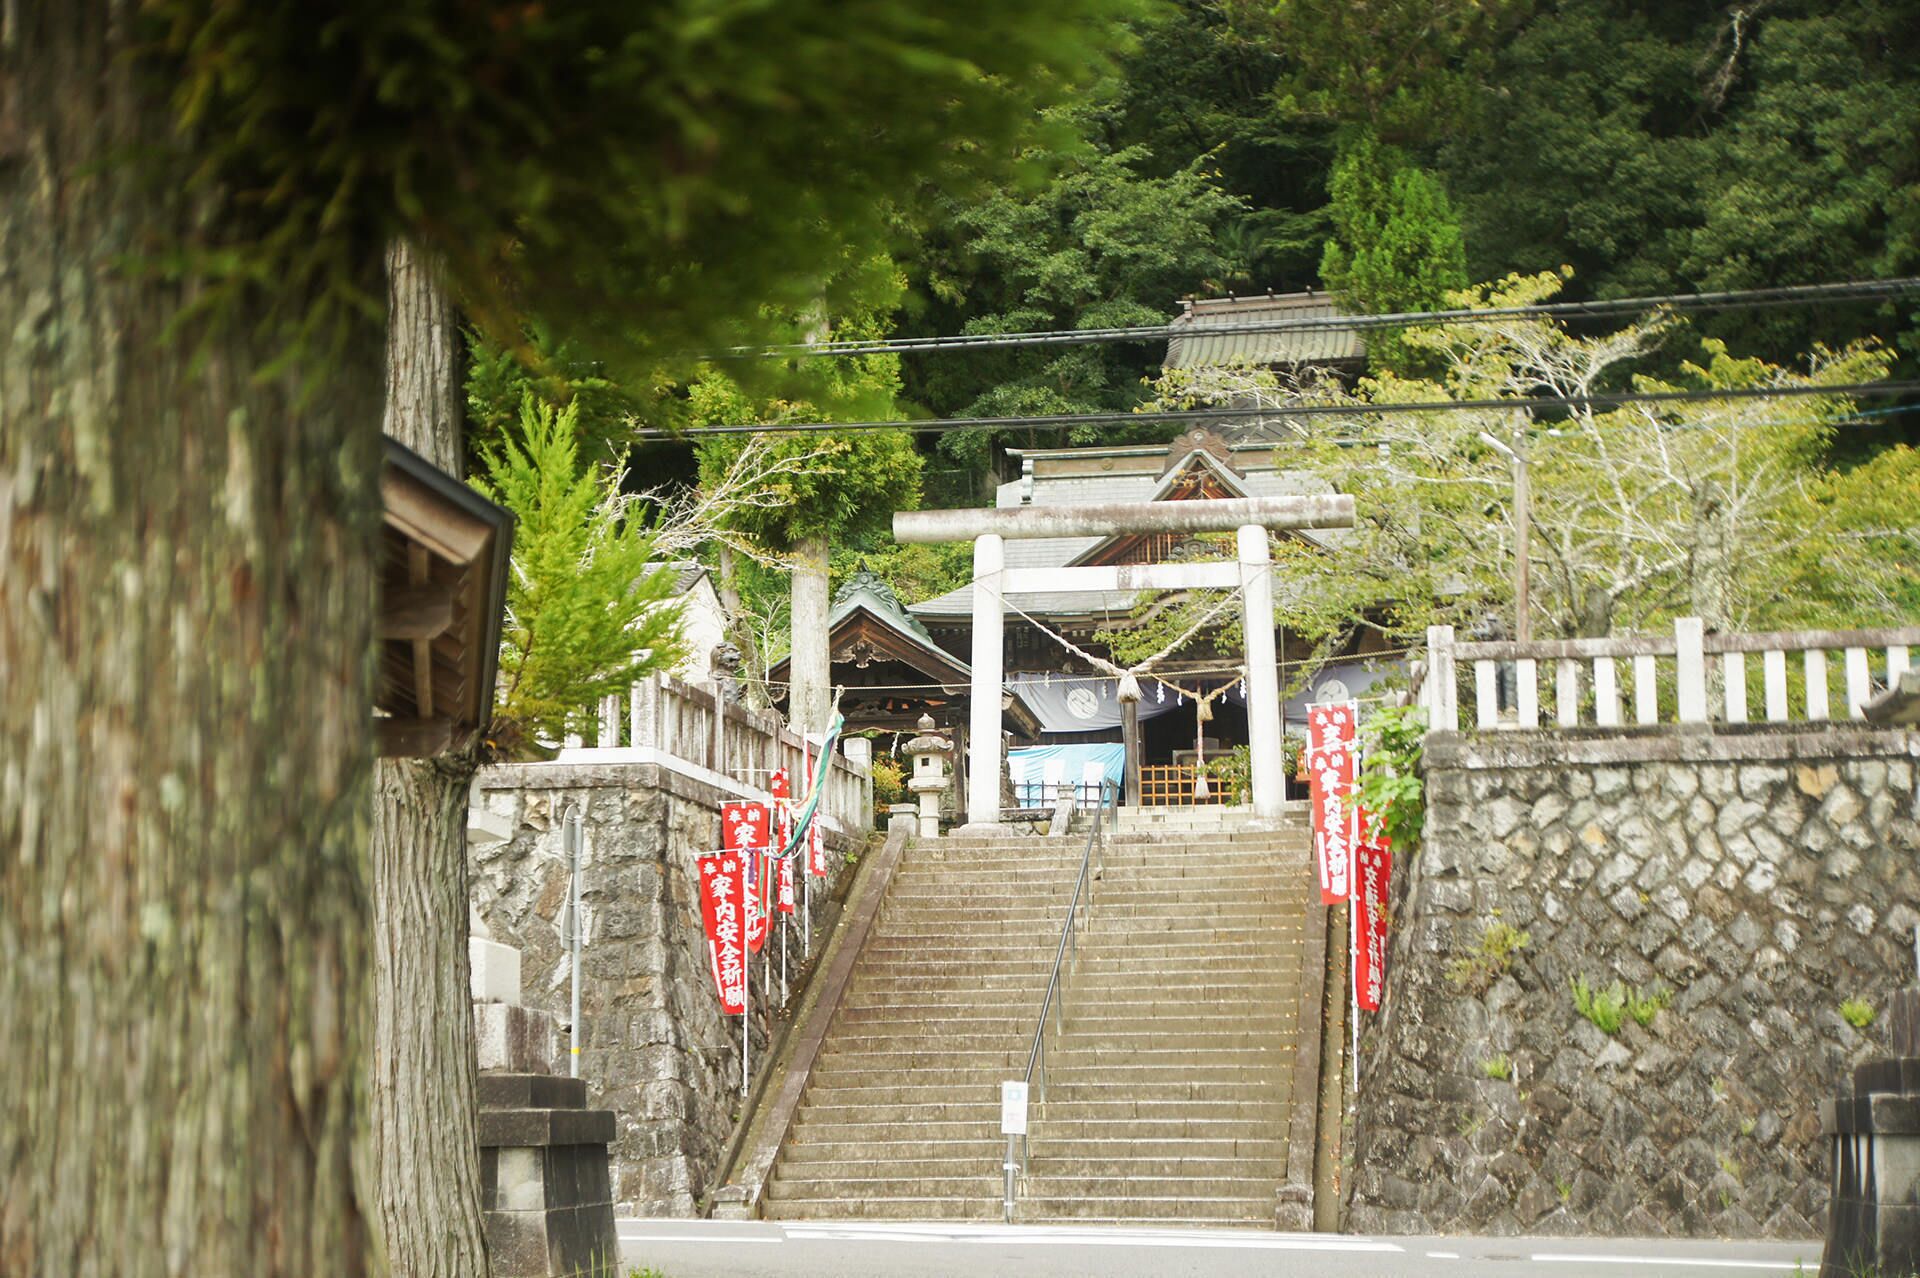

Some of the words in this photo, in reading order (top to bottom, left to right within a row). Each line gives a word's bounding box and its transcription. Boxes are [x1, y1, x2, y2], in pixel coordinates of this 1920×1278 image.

[702, 859, 737, 875] 奉納
[709, 873, 745, 1007] 家内安全祈願
